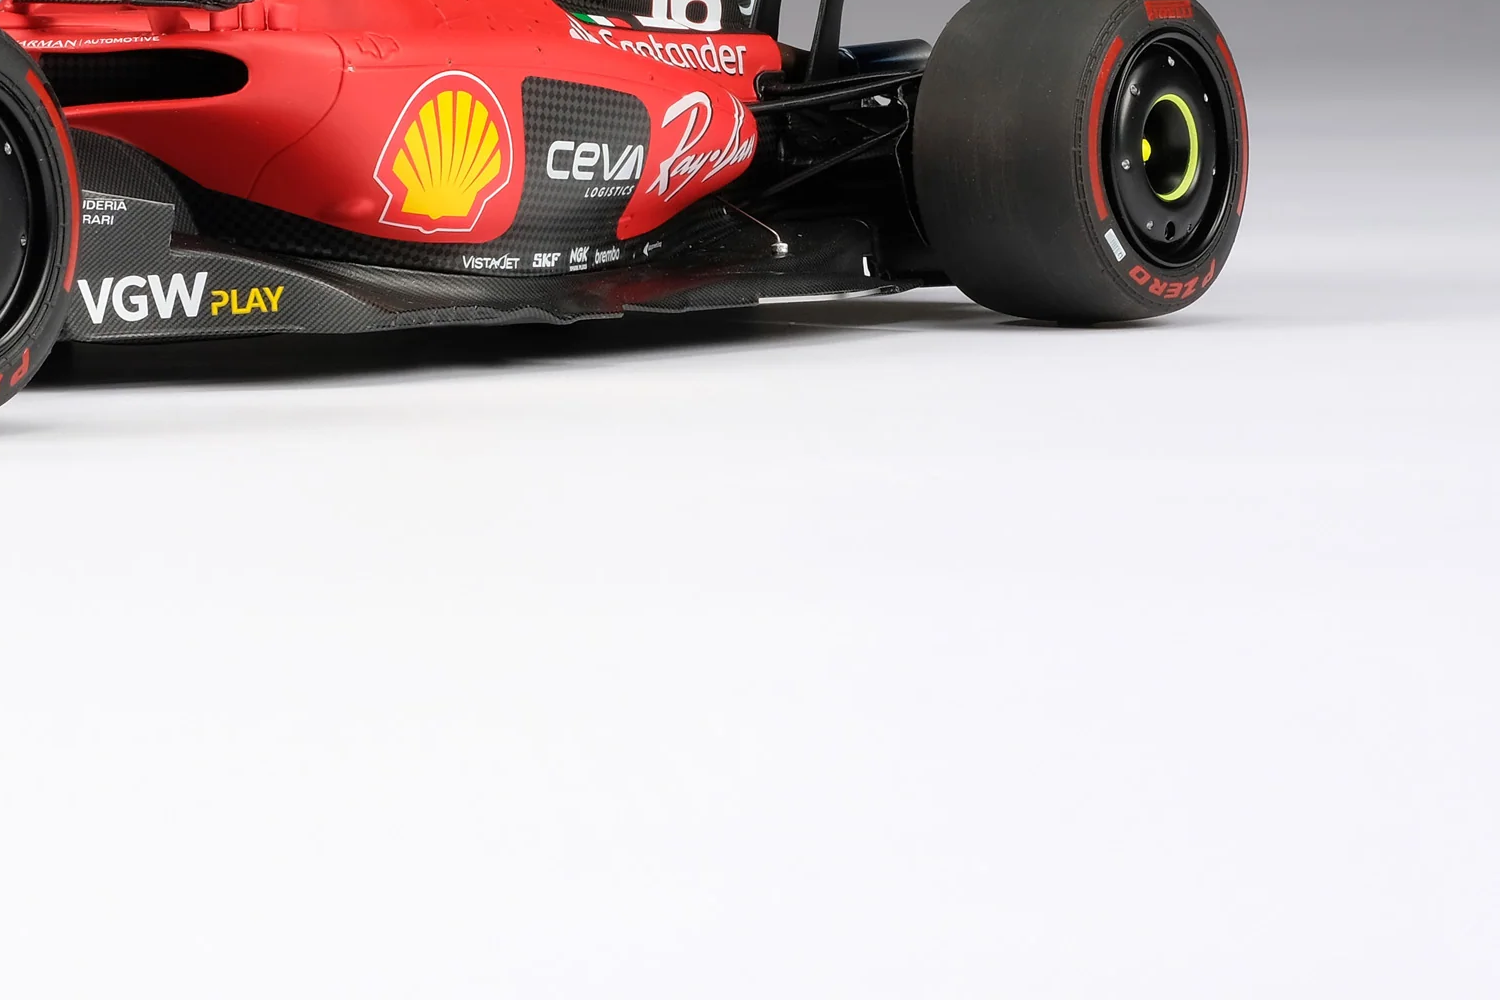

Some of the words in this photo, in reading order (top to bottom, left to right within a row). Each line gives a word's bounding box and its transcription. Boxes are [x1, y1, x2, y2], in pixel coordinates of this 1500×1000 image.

[83, 35, 160, 46] AUTOMOTIVE
[584, 185, 635, 199] LOGISTICS
[532, 252, 561, 268] SKF
[569, 245, 590, 264] NGK
[594, 245, 620, 265] brembo
[1128, 265, 1200, 299] ZERO
[77, 271, 208, 325] VGW
[211, 286, 285, 317] PLAY
